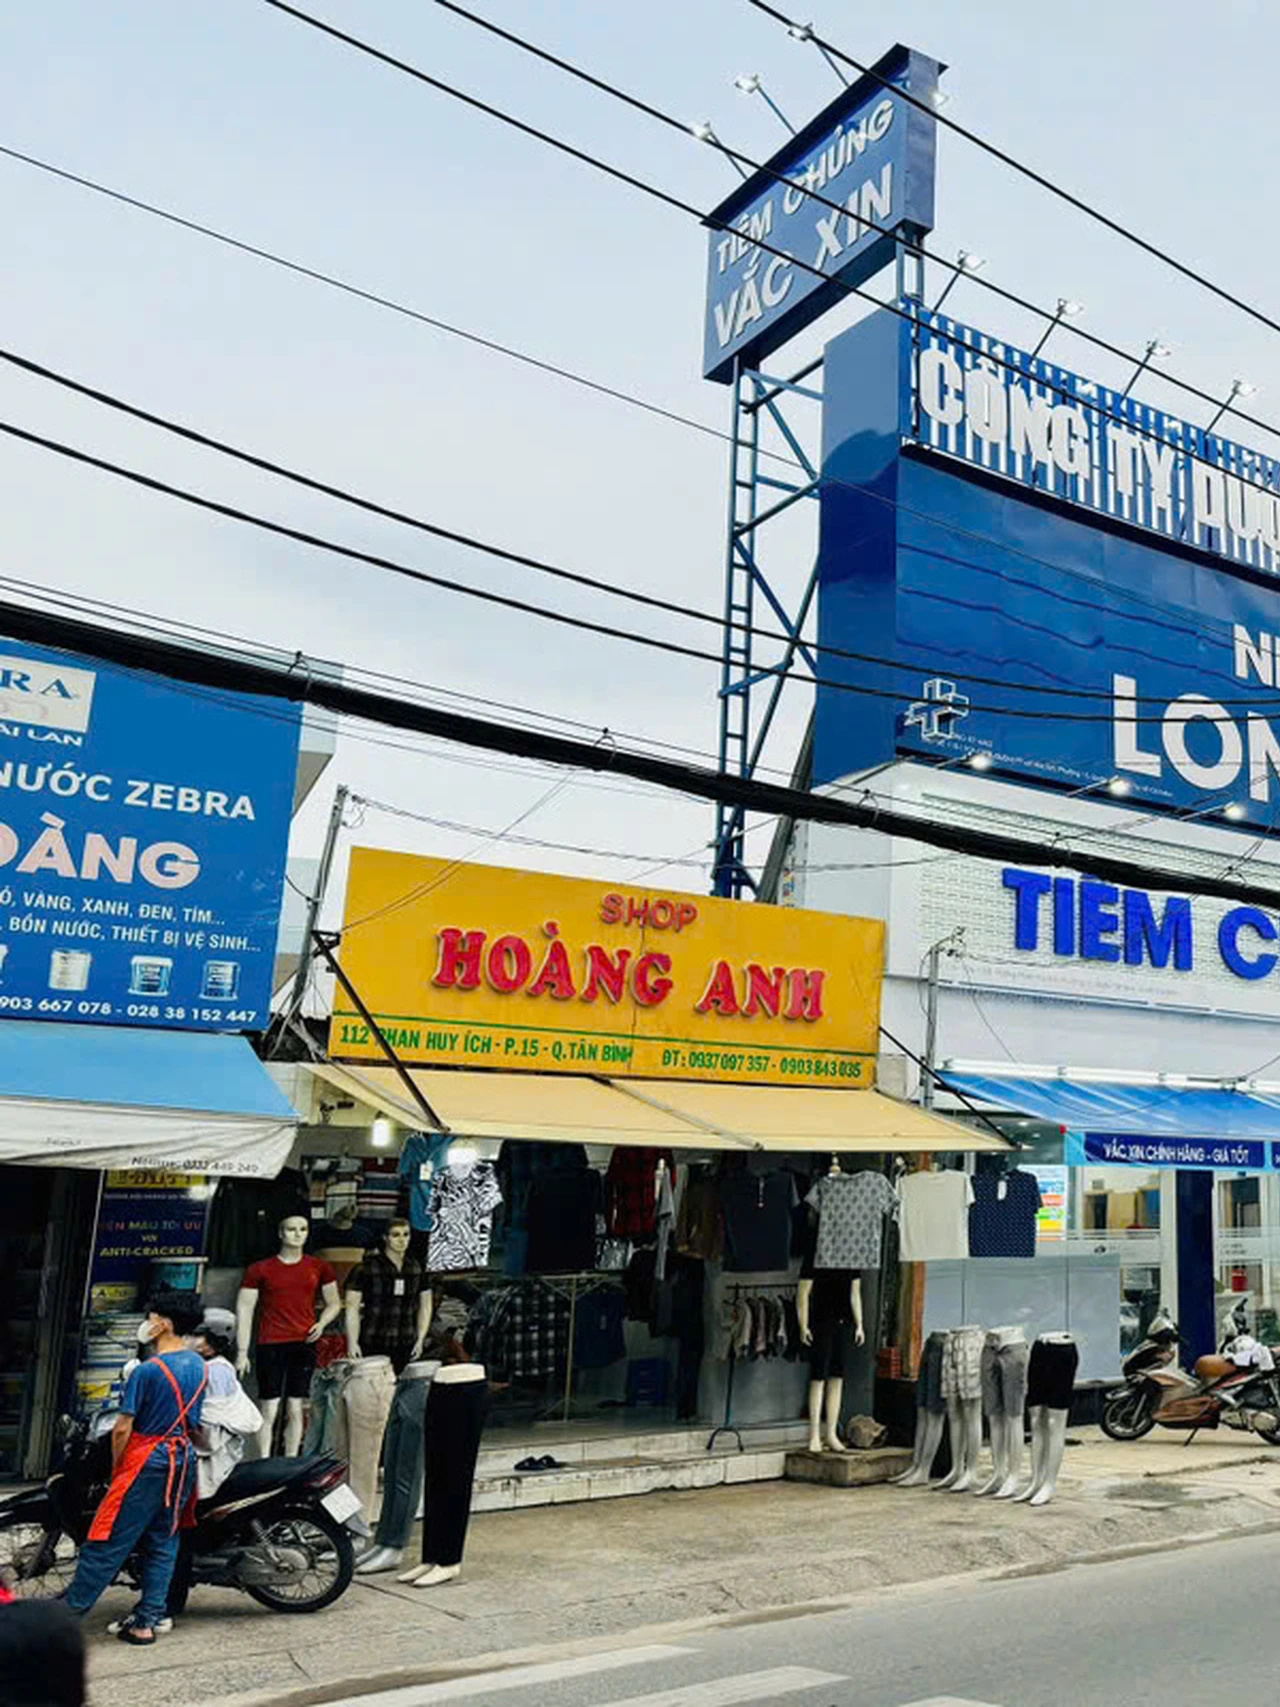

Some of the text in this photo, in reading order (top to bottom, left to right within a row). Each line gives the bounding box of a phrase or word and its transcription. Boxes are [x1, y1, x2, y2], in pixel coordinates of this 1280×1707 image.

[813, 162, 894, 271] XIN
[919, 347, 1090, 480] CÔNG
[1108, 426, 1176, 510] TY
[27, 728, 83, 748] LAN
[124, 780, 256, 820] ZEBRA
[82, 897, 133, 918] XANH,
[600, 893, 699, 932] SHOP
[433, 921, 827, 1022] HOÀNG ANH
[341, 1024, 370, 1045] 112
[426, 1030, 460, 1051] HUY
[463, 1029, 493, 1053] ÍCH
